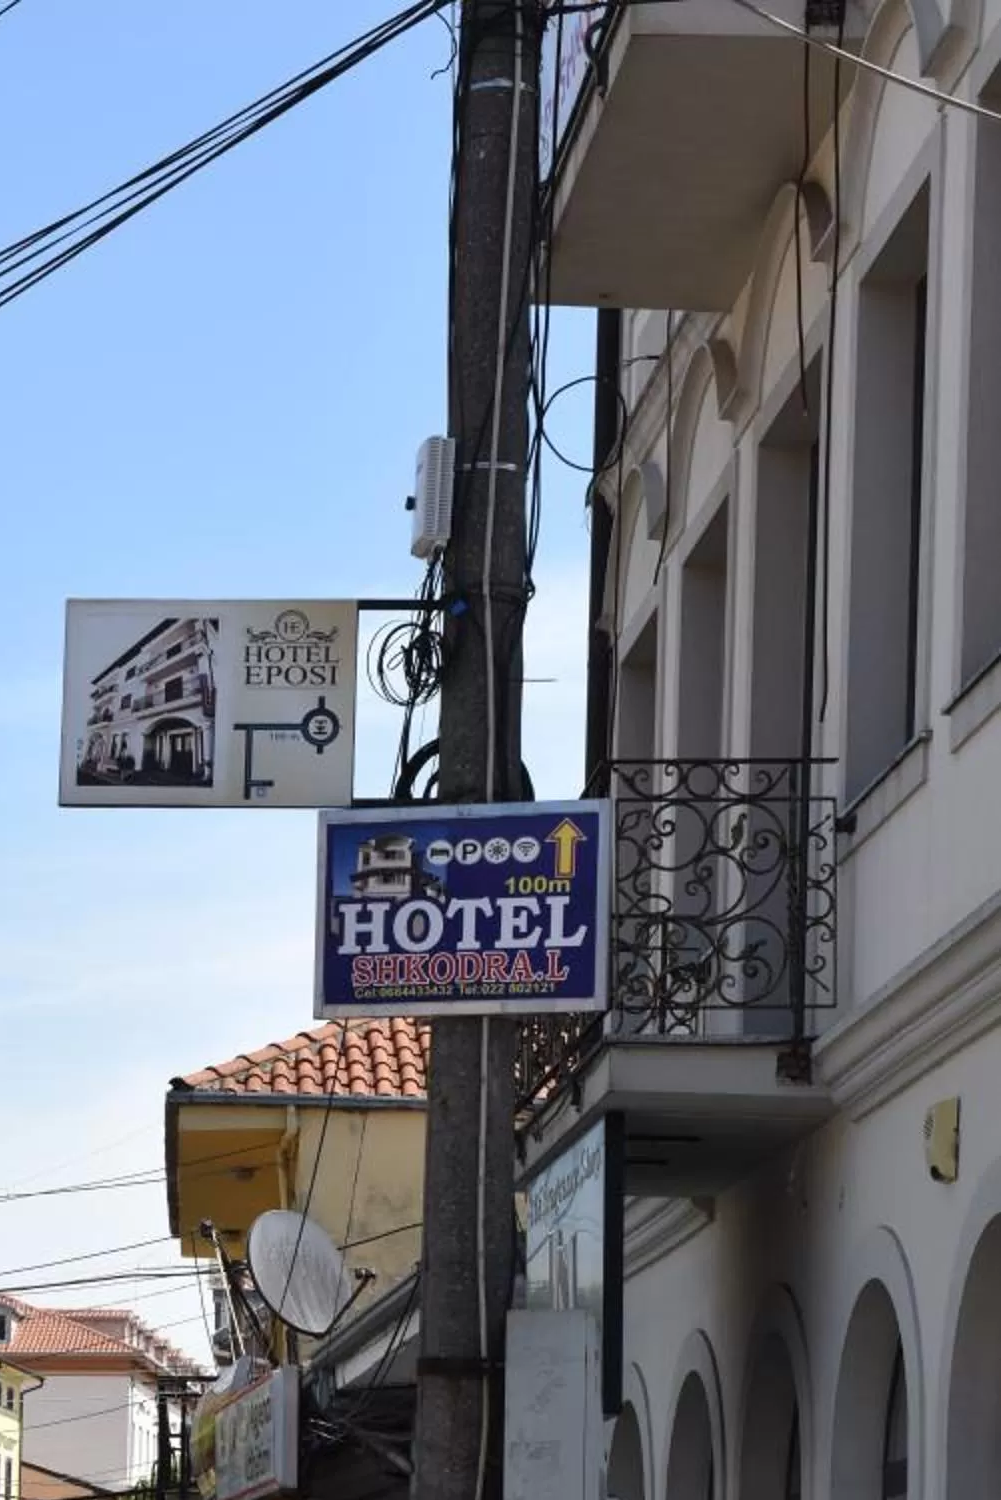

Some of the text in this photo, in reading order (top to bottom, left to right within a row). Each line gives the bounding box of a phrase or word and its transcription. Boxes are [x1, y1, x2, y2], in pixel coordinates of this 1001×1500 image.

[244, 645, 340, 663] HOTEL
[245, 665, 339, 686] EPOSI
[504, 876, 570, 895] 100m
[337, 896, 588, 954] HOTEL
[351, 949, 570, 987] SHKODRA.L
